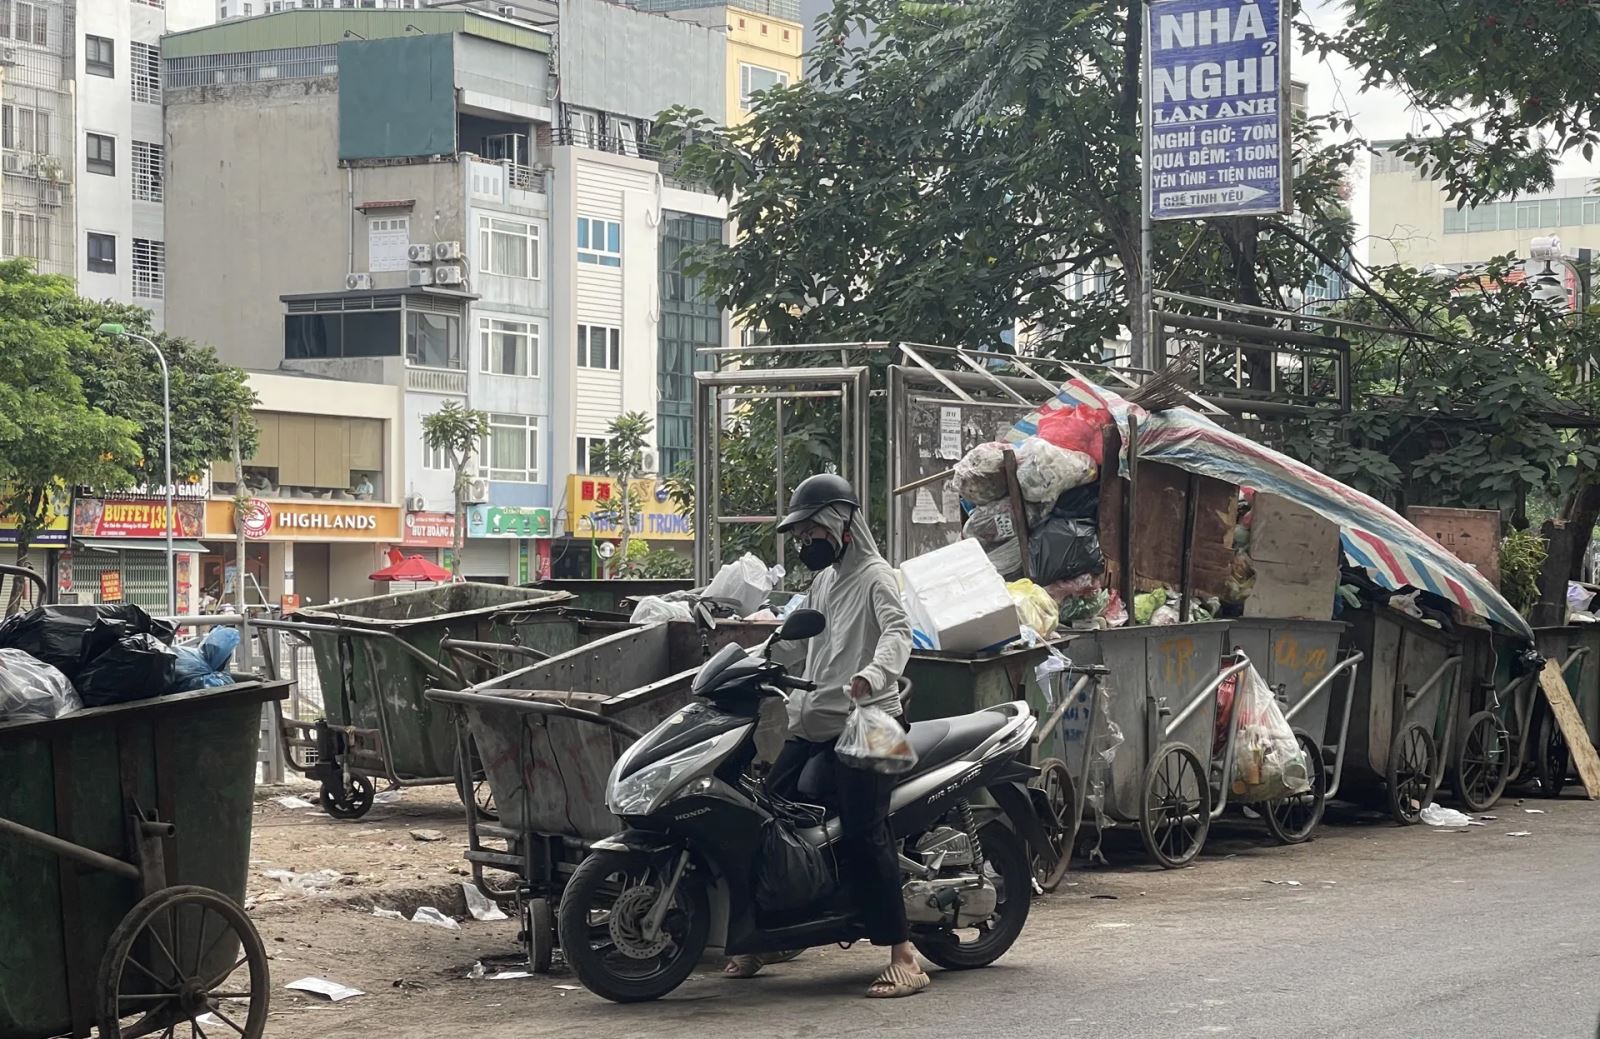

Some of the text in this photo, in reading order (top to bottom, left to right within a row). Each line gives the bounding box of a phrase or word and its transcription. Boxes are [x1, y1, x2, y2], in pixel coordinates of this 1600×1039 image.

[1160, 0, 1267, 50] NHÀ
[1152, 41, 1277, 103] NGHỈ
[1153, 97, 1277, 124] LAN ANH
[1153, 123, 1277, 149] NGHỈ GIỜ: 70N
[1153, 152, 1185, 171] QUA
[1189, 147, 1230, 166] ĐÊM:
[1153, 171, 1176, 188] YÊN
[1217, 166, 1244, 184] TIỆN
[1247, 165, 1277, 180] NGHI
[1190, 191, 1217, 205] TÌNH
[1221, 189, 1244, 202] YÊU
[103, 504, 150, 522] BUFFET
[279, 512, 377, 529] HIGHLANDS
[674, 806, 712, 821] HONDA
